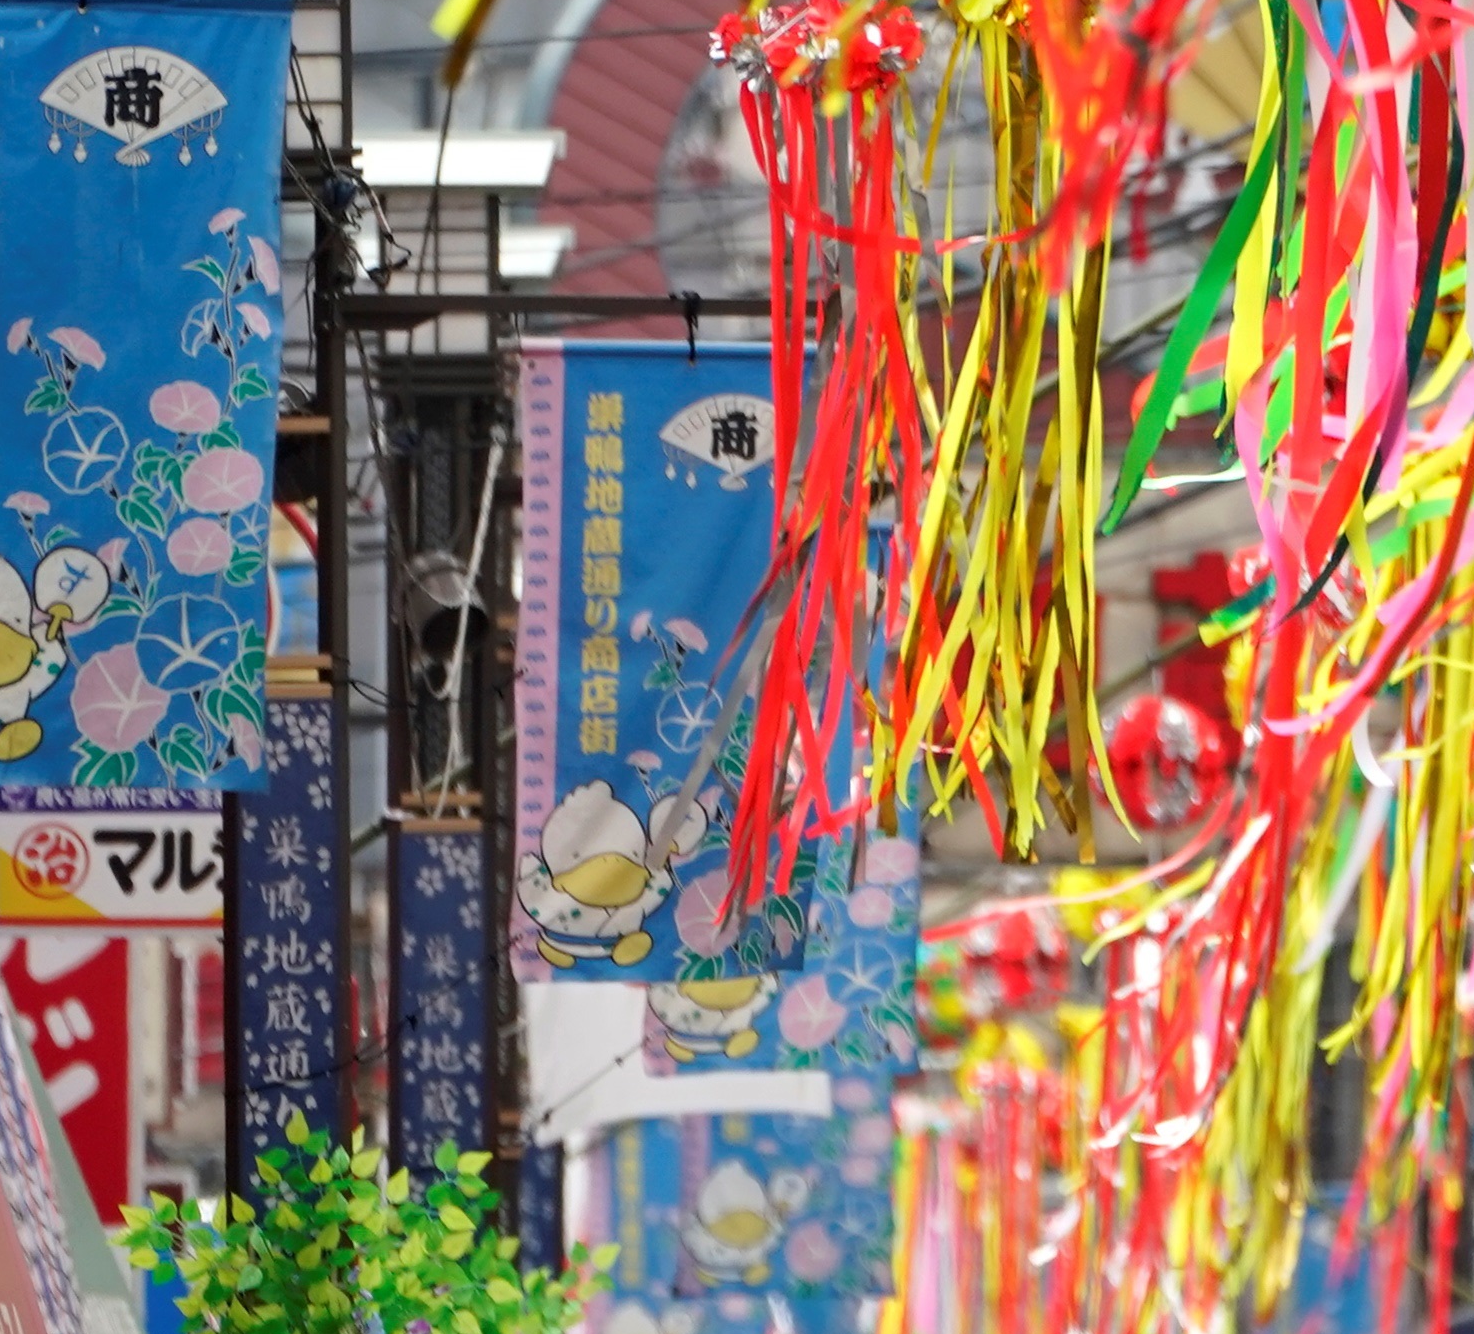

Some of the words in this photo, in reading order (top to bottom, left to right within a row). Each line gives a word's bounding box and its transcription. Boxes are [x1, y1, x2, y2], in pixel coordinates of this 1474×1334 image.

[104, 67, 164, 130] 商
[709, 411, 758, 463] 商
[578, 391, 626, 757] 巣鴨地蔵通り商店街
[92, 829, 223, 895] マル
